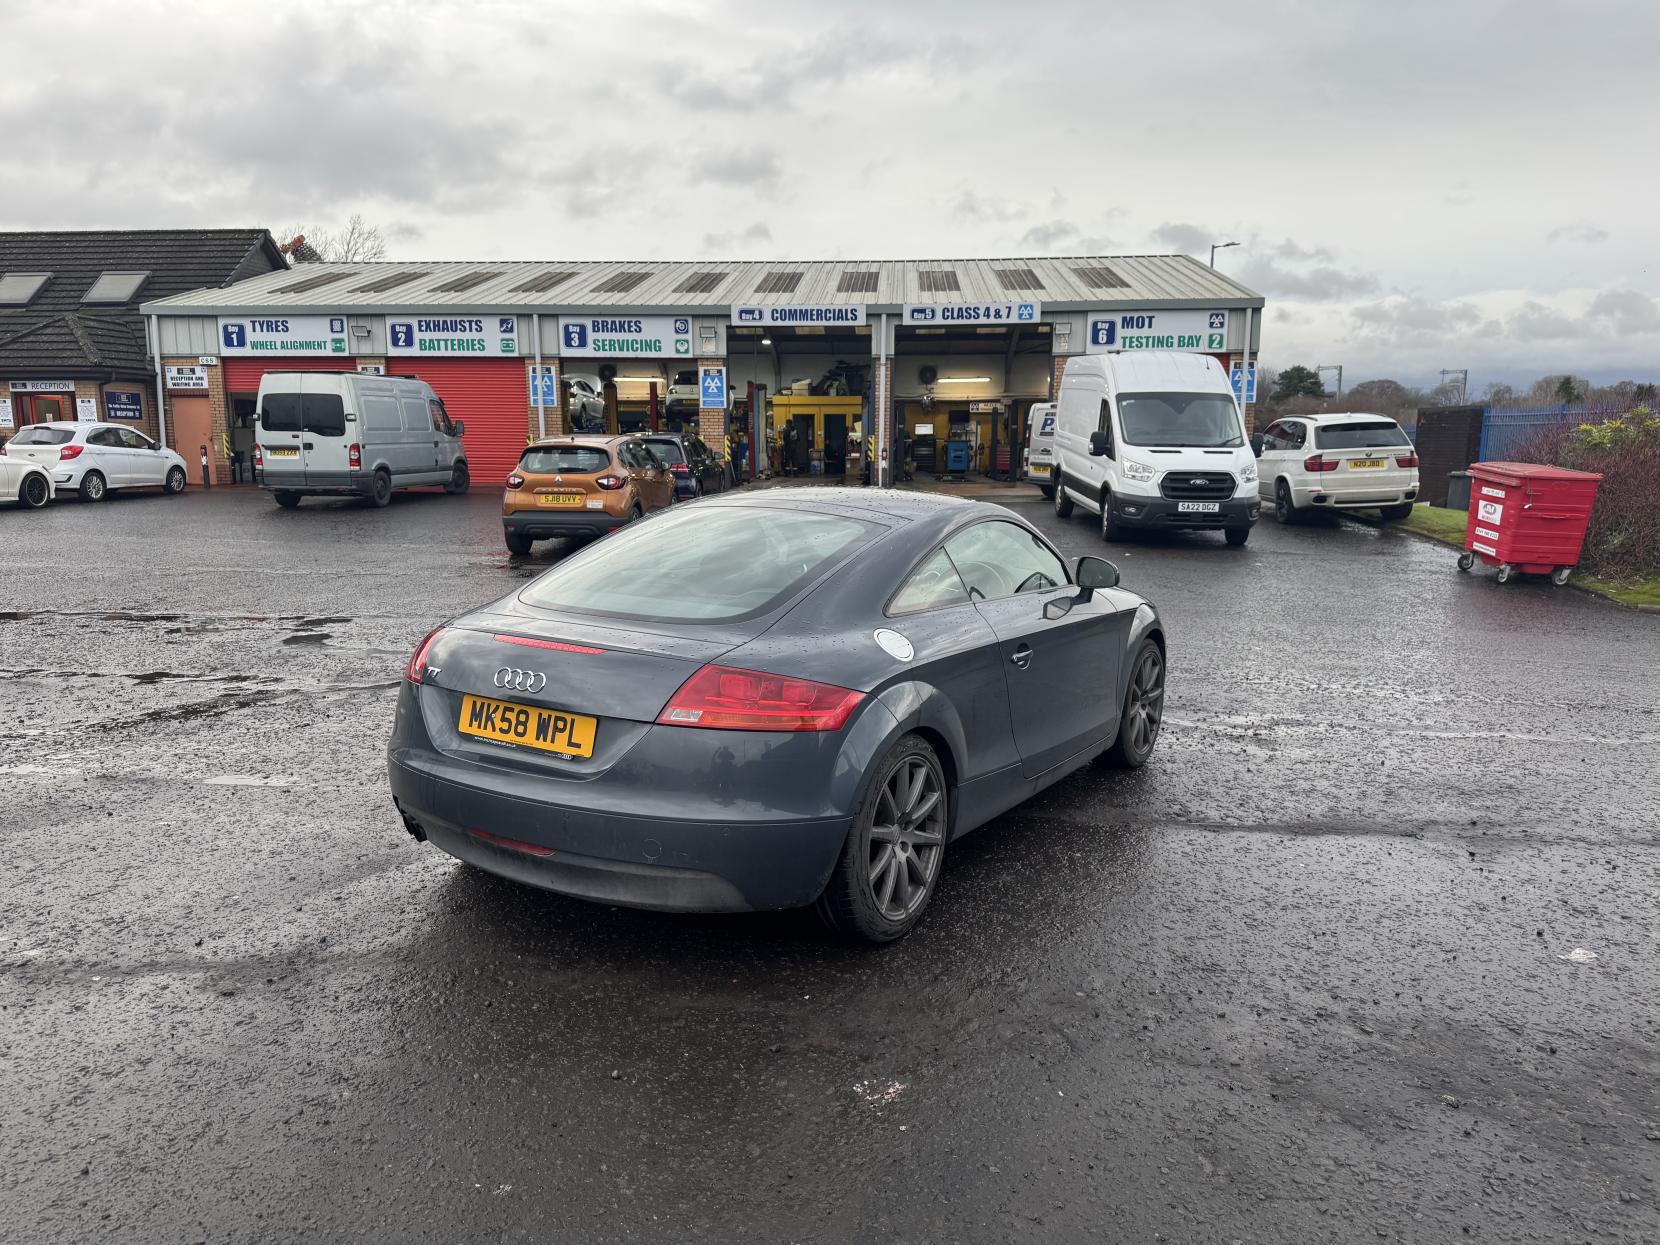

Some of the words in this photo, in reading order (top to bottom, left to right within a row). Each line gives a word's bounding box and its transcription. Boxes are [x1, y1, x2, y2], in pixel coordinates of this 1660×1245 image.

[754, 310, 760, 320] 4
[771, 308, 858, 321] COMMERCIALS
[926, 309, 932, 318] 5
[942, 307, 980, 320] CLASS
[983, 306, 991, 320] 4
[994, 309, 1002, 319] &
[1006, 306, 1012, 319] 7
[250, 320, 289, 332] TYRES
[418, 320, 482, 332] EXHAUSTS
[569, 325, 580, 333] Bay
[592, 320, 642, 333] BRAKES
[1097, 322, 1109, 330] Bay
[1121, 316, 1154, 329] MOT
[231, 333, 238, 346] 1
[398, 333, 406, 346] 2
[570, 332, 579, 346] 3
[1099, 330, 1108, 344] 6
[1121, 336, 1174, 349] TESTING
[1178, 335, 1202, 348] BAY
[1211, 334, 1220, 348] 2
[250, 340, 278, 350] WHEEL
[280, 340, 327, 350] ALIGNMENT
[420, 338, 486, 352] BATTERIES
[593, 339, 662, 352] SERVICING
[468, 700, 530, 738] MK58
[536, 712, 582, 749] WPL
